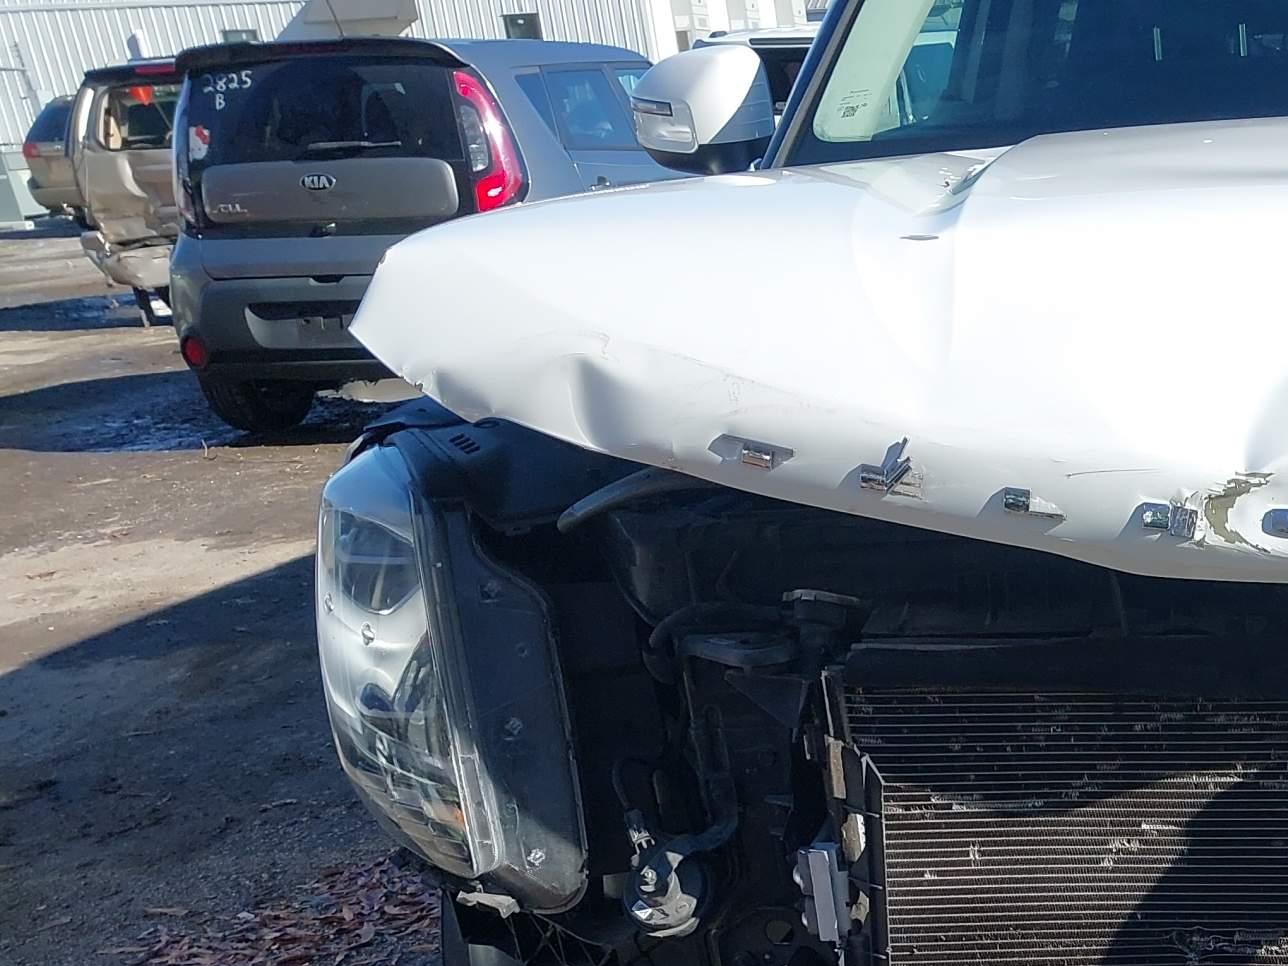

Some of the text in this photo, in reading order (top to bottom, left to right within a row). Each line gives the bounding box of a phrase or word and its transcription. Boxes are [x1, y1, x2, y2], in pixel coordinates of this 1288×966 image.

[202, 70, 252, 93] 2825
[215, 93, 226, 111] B
[303, 175, 330, 189] KIA
